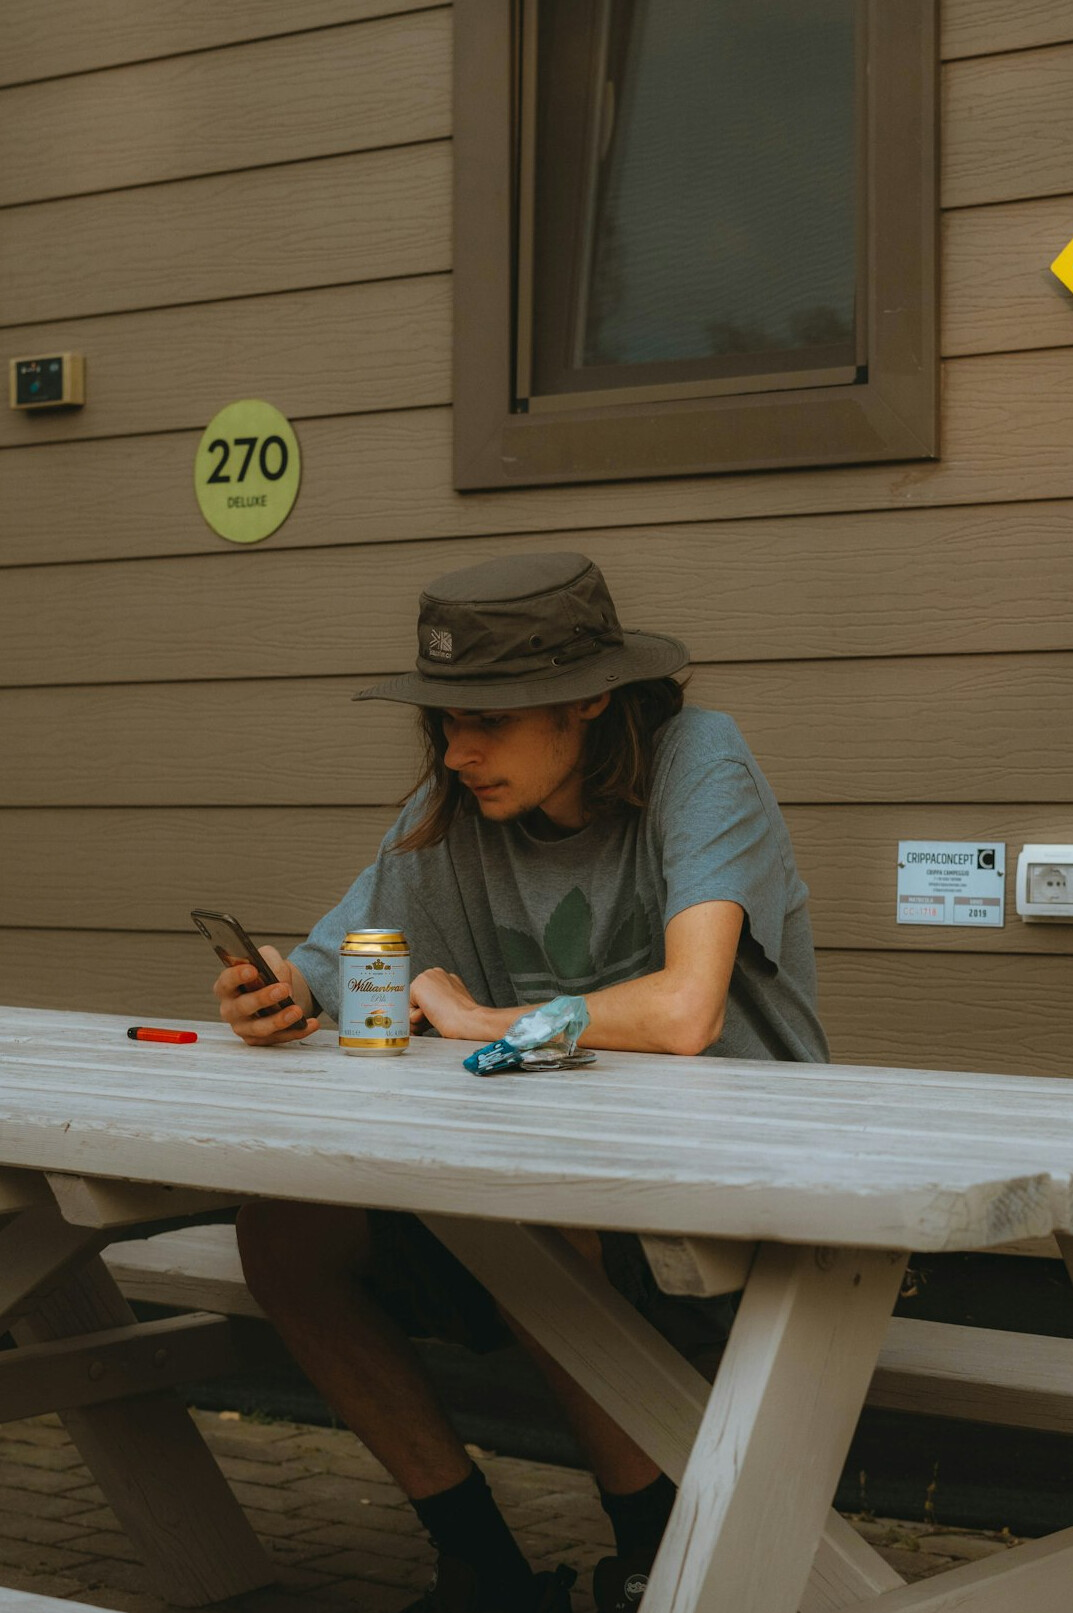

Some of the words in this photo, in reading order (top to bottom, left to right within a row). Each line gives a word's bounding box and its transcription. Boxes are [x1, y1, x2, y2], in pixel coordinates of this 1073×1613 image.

[207, 435, 289, 484] 270
[227, 495, 267, 508] DELUXE
[906, 852, 974, 865] CRIPPACONCEPT
[968, 908, 988, 918] 2019
